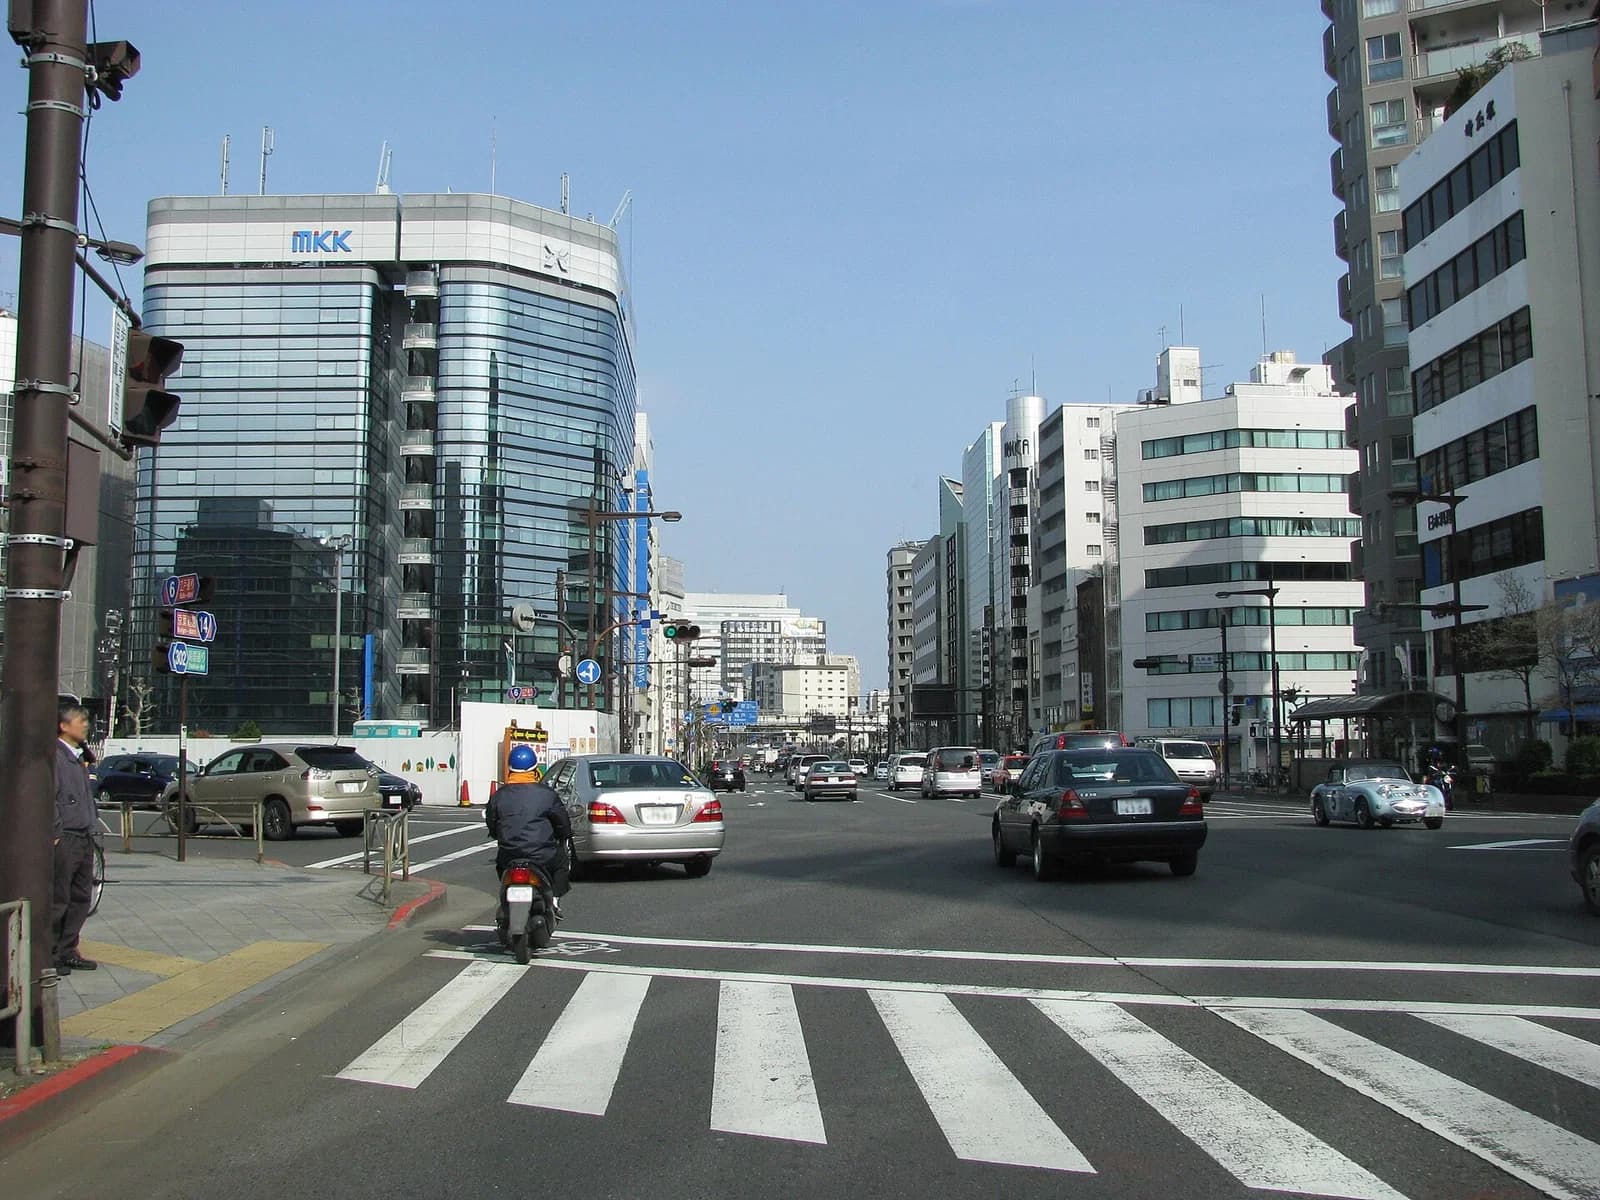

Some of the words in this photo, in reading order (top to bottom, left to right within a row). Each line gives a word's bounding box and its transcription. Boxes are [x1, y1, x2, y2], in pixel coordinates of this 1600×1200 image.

[292, 230, 352, 252] MKK
[169, 581, 175, 598] 6
[199, 616, 208, 634] 14
[176, 649, 187, 666] 302
